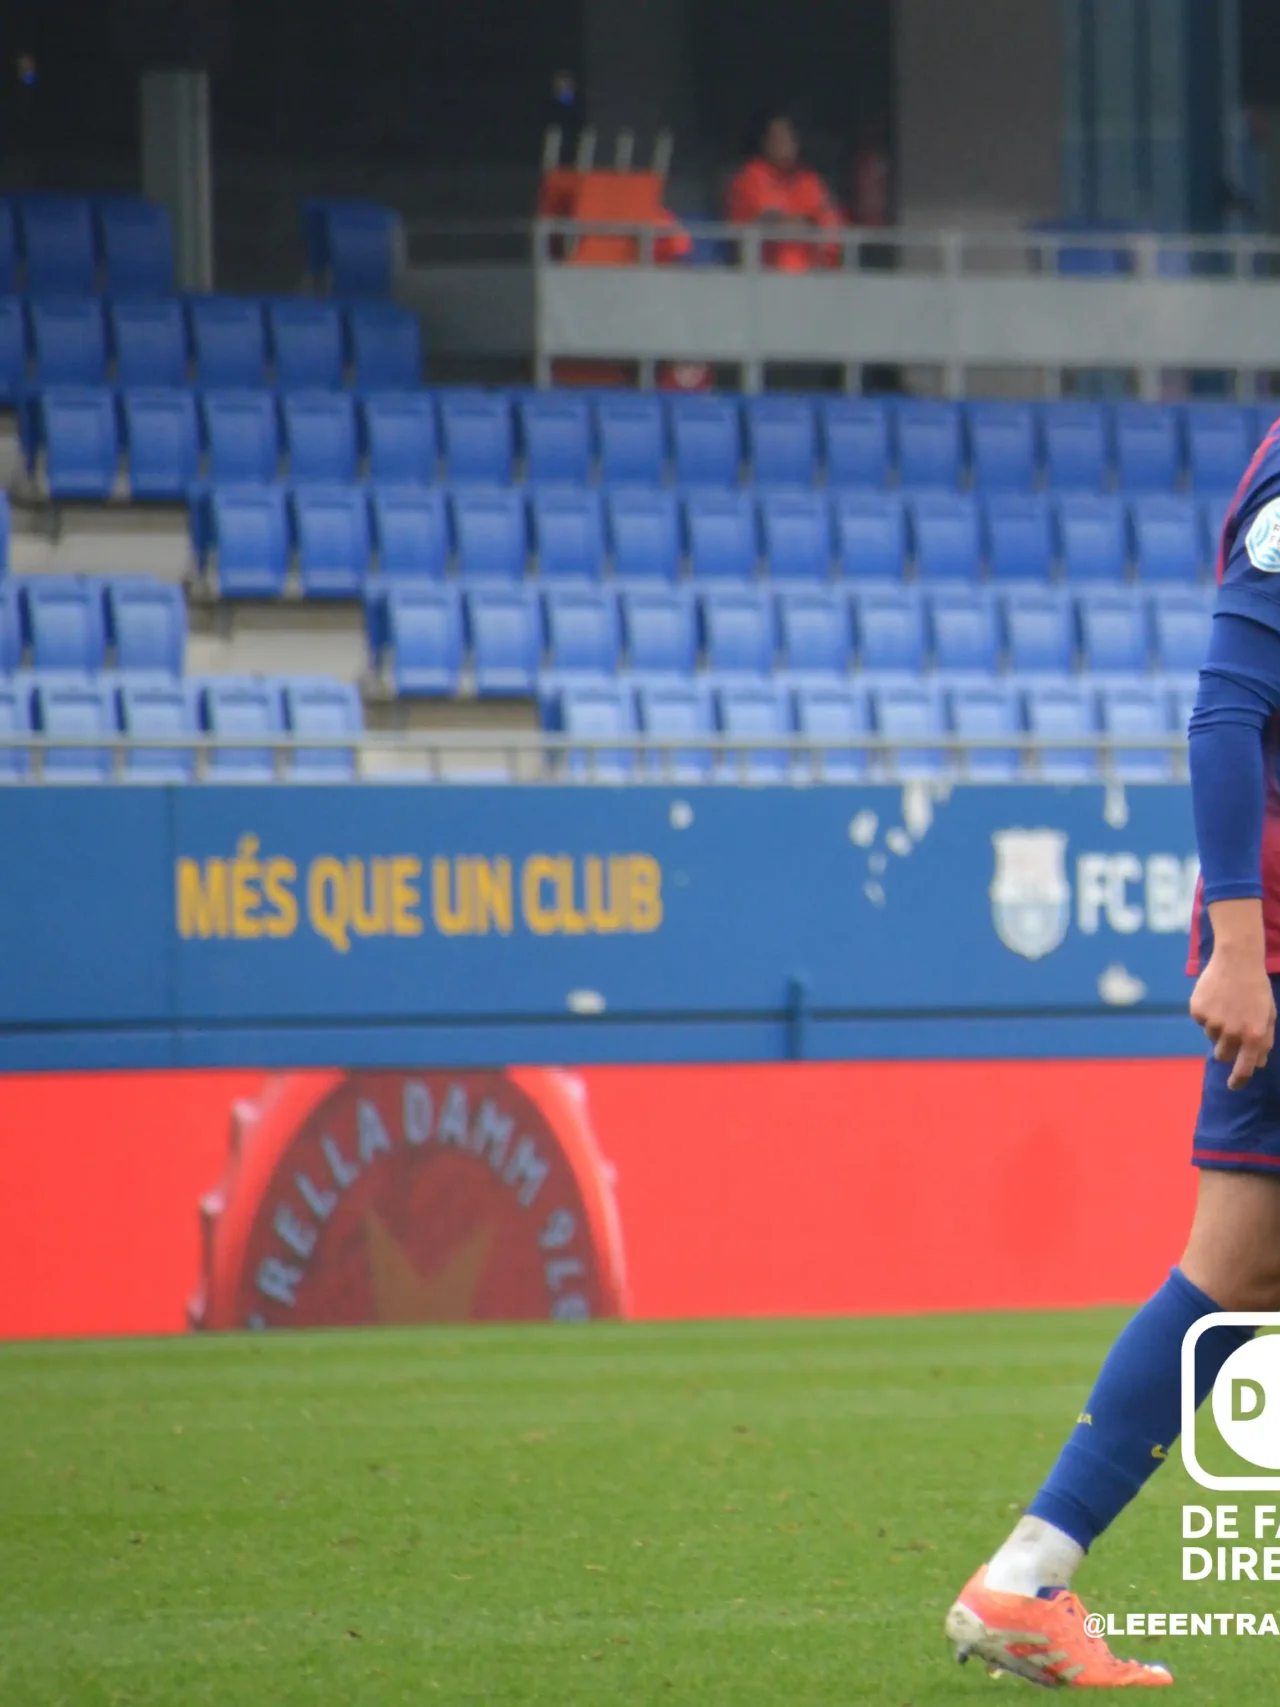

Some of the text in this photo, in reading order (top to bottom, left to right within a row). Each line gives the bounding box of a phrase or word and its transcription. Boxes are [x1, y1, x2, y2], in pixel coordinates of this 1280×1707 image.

[177, 835, 662, 951] MÉS QUE UN CLUB
[1076, 851, 1143, 935] FC
[248, 1077, 550, 1331] RELLA DAMM
